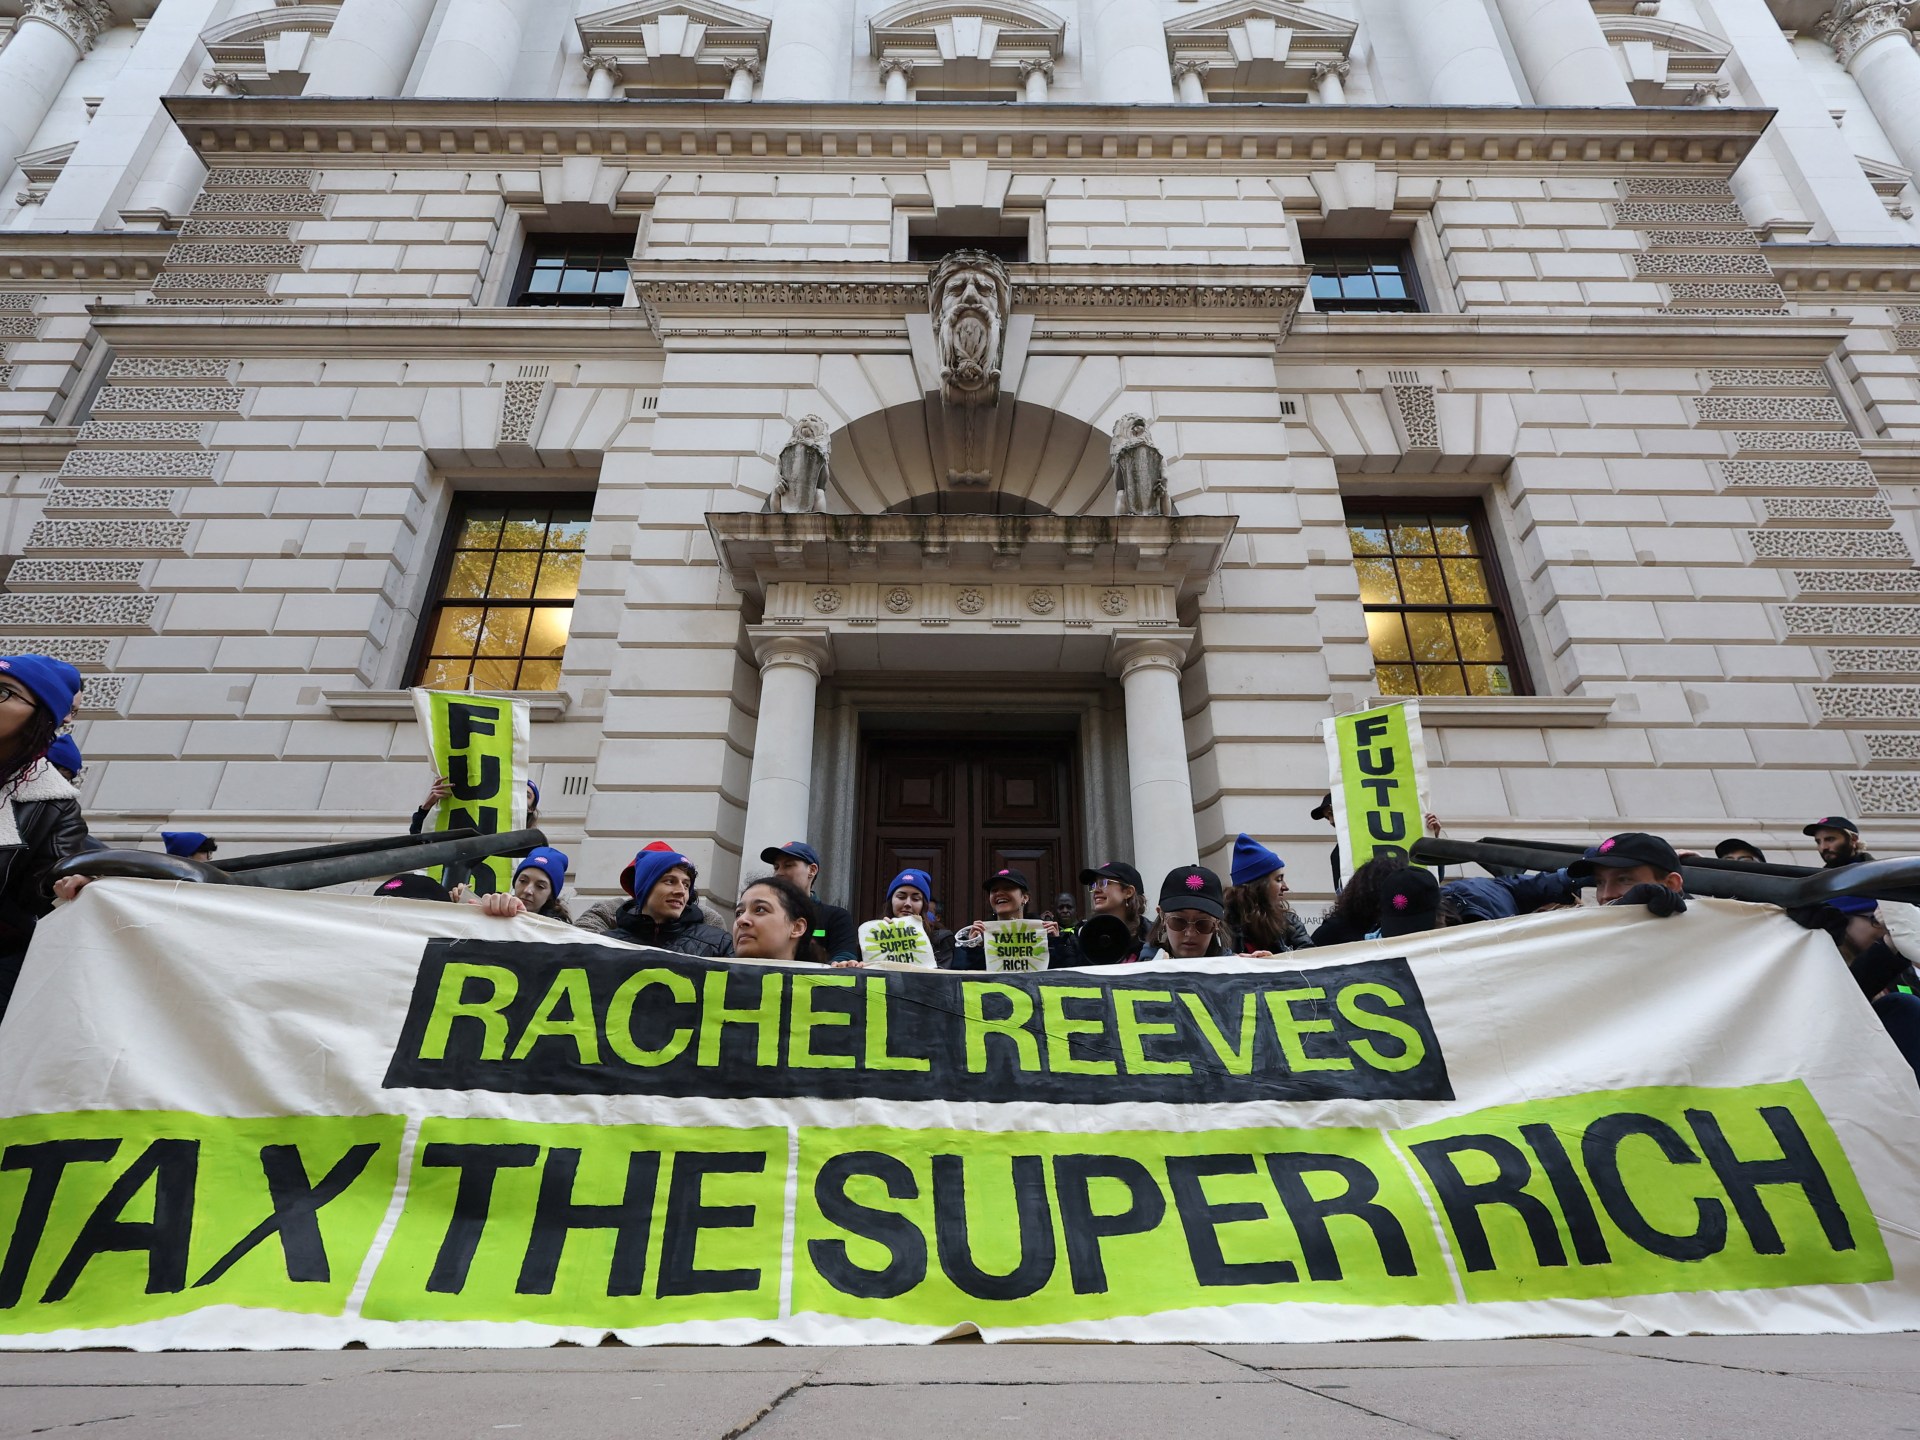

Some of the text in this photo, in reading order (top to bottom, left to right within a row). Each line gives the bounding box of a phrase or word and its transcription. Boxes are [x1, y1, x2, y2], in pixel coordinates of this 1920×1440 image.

[871, 926, 918, 941] TAX THE
[992, 932, 1037, 944] TAX THE
[879, 939, 917, 953] SUPER
[997, 946, 1033, 957] SUPER
[887, 952, 914, 963] RICH
[1003, 959, 1029, 971] RICH
[418, 963, 1426, 1076] RACHEL REEVES
[0, 1105, 1857, 1309] TAX THE SUPER RICH
